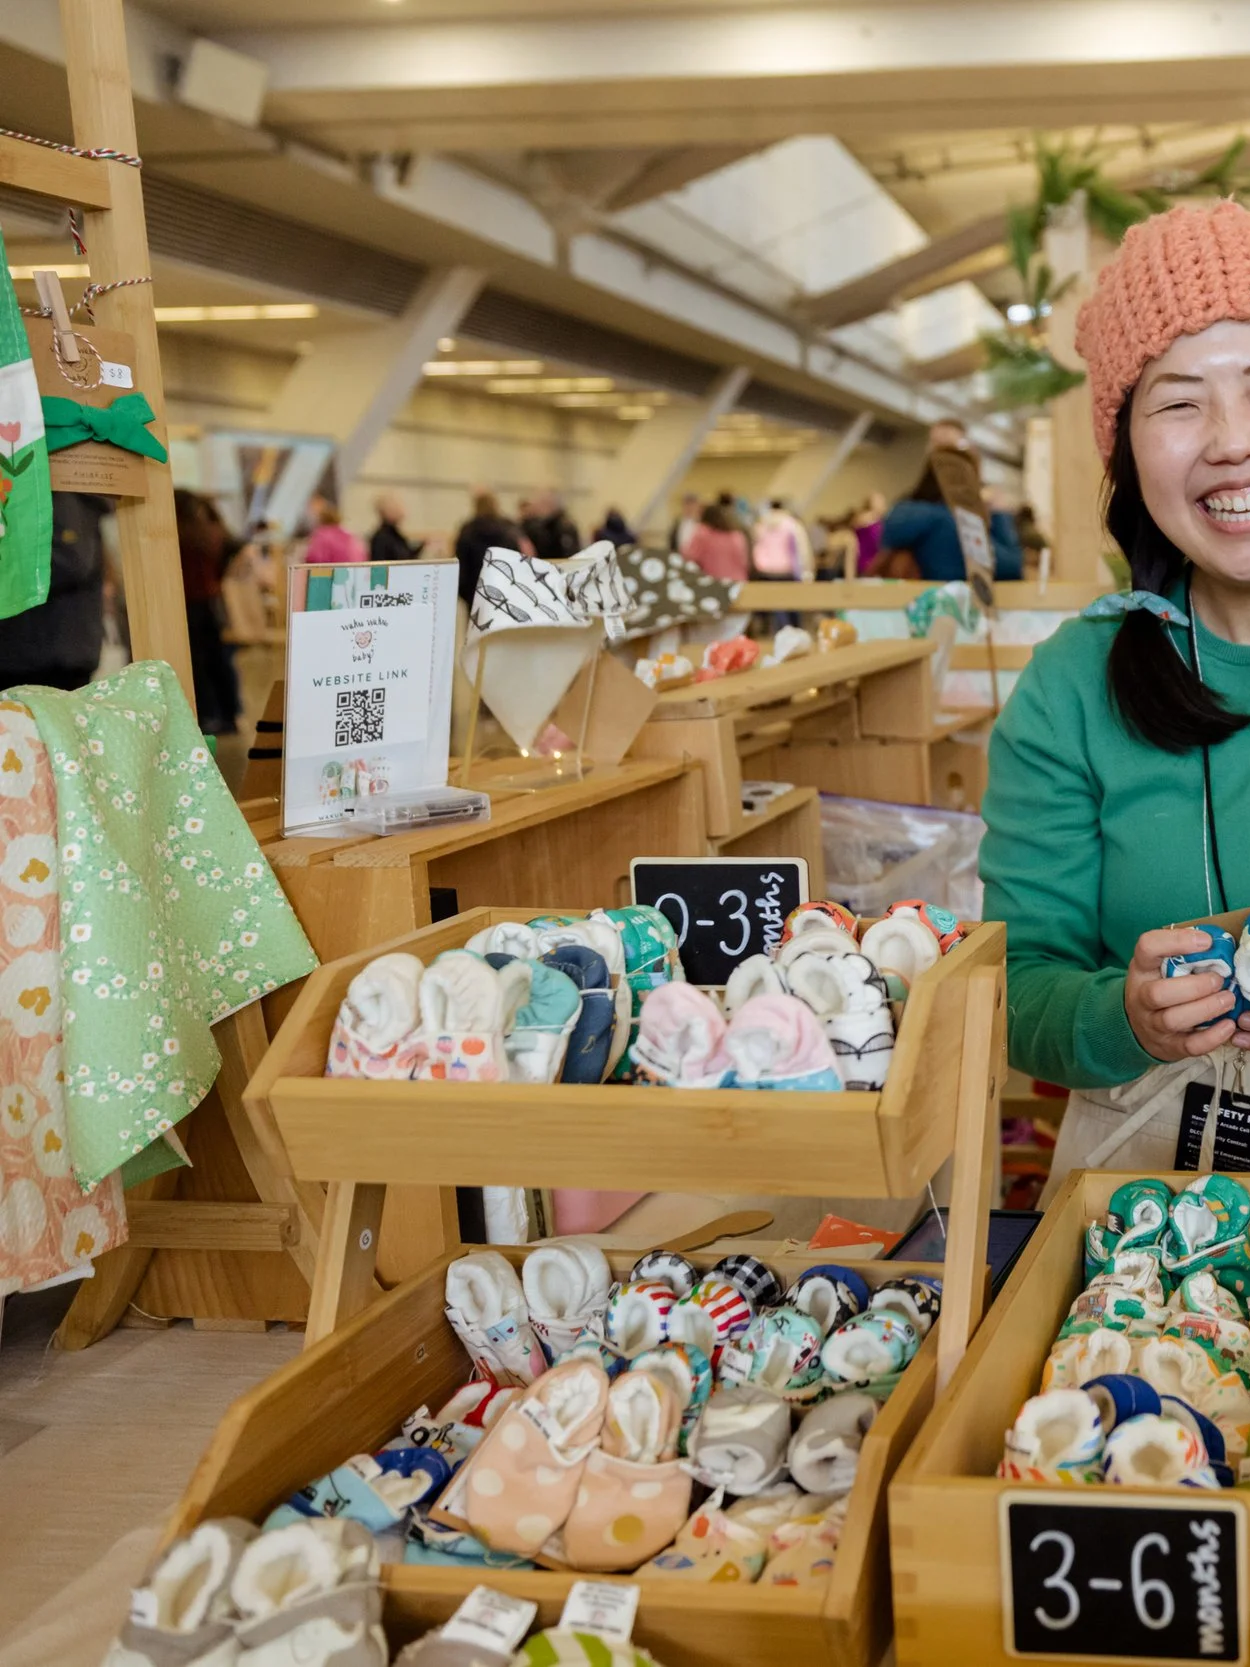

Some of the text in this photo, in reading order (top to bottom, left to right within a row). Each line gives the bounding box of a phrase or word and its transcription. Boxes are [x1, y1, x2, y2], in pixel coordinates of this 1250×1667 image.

[312, 668, 409, 687] WEBSITE LINK
[1202, 1104, 1245, 1121] SFETY
[1029, 1529, 1175, 1631] 3-6
[1186, 1518, 1225, 1655] months
